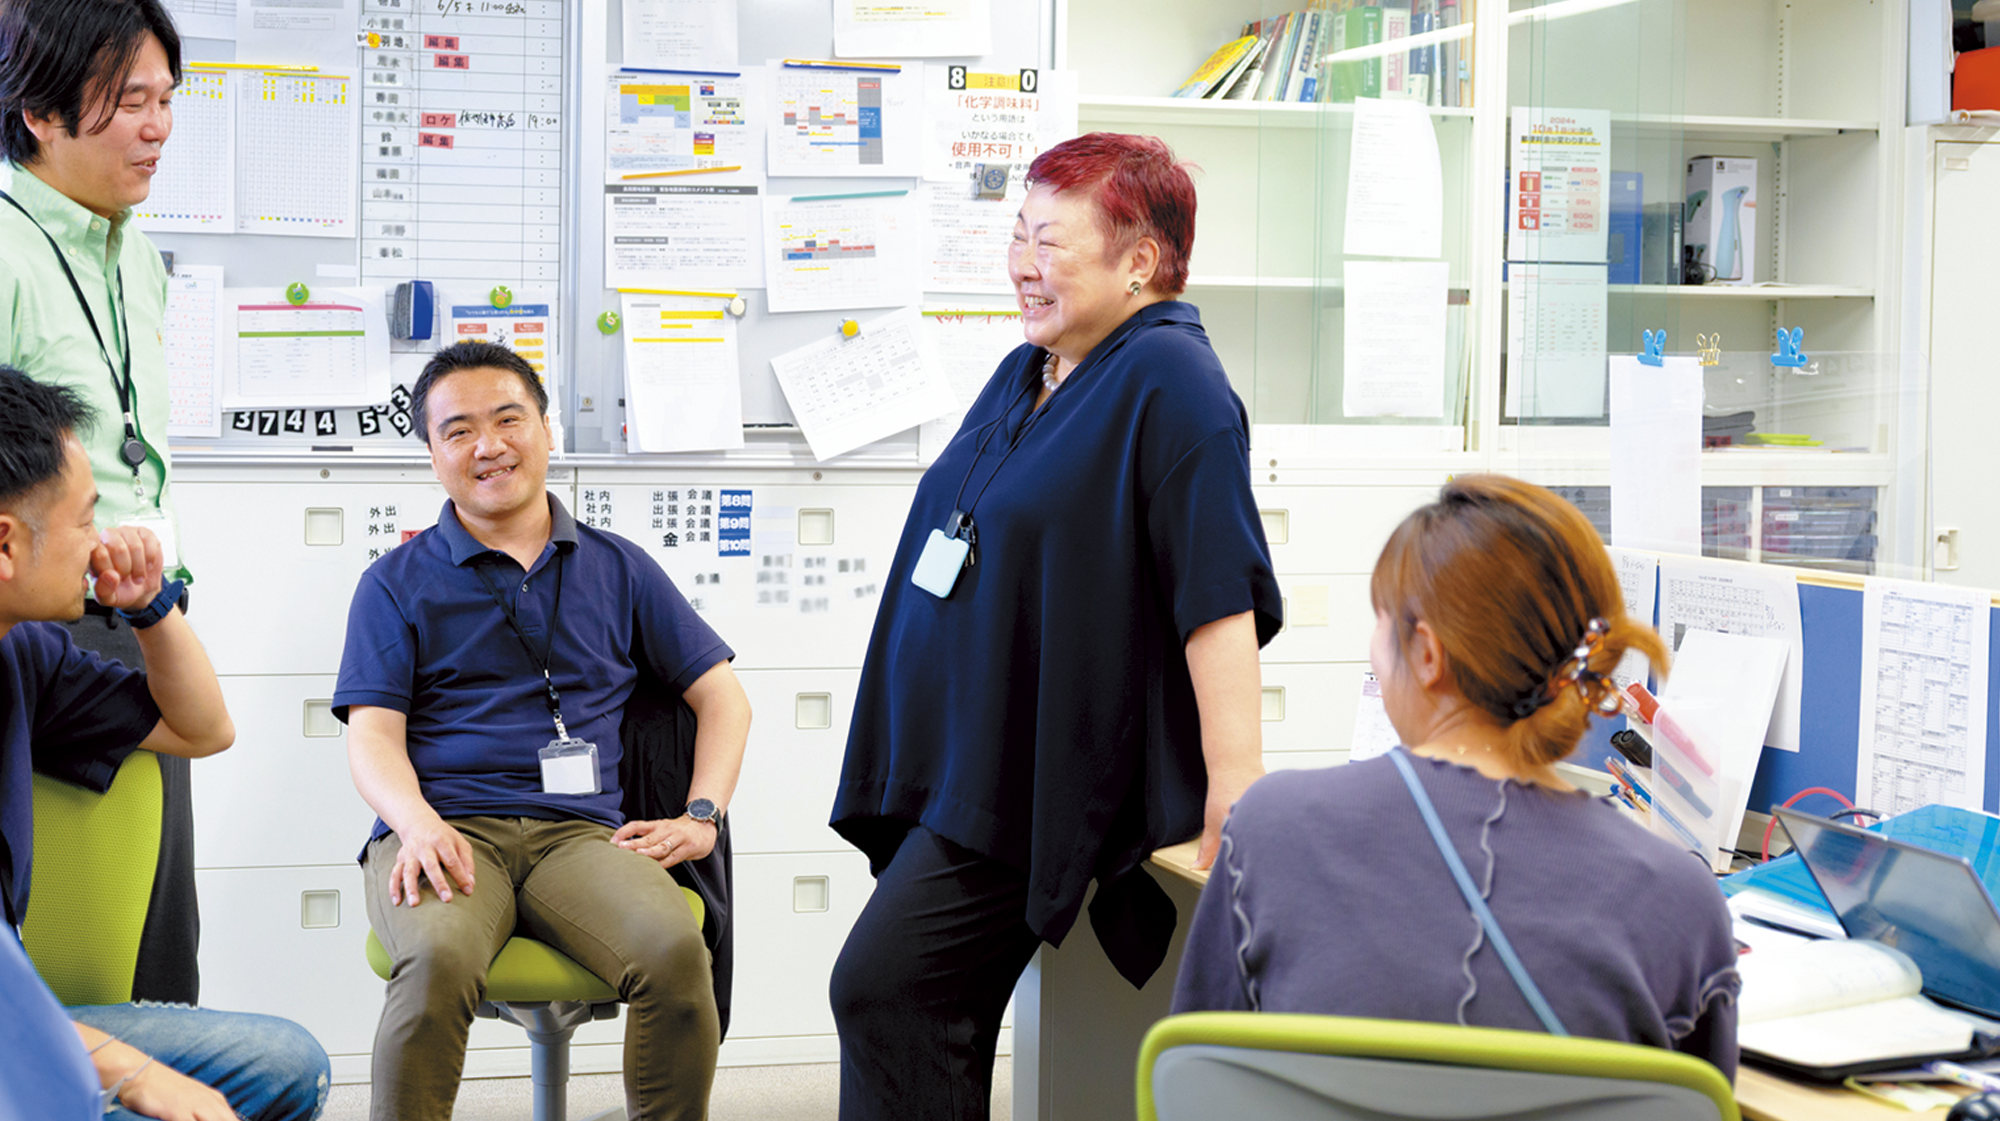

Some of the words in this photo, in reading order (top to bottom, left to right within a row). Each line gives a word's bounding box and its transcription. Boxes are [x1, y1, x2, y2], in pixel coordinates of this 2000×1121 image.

[951, 67, 965, 88] 8
[1022, 70, 1035, 91] 0
[958, 94, 1040, 112] 「化学調味料」
[426, 115, 451, 125] ロケ
[972, 113, 1025, 123] という用語は
[392, 389, 411, 410] 3
[261, 412, 275, 433] 7
[287, 408, 302, 430] 4
[318, 411, 334, 432] 4
[363, 411, 376, 433] 5
[393, 411, 411, 434] 9
[584, 490, 610, 501] 社内
[653, 490, 678, 501] 出張
[688, 489, 712, 500] 会議
[369, 505, 397, 518] 外出
[586, 503, 611, 514] 社内
[653, 504, 678, 515] 出張
[686, 504, 711, 515] 会議
[586, 516, 611, 527] 社内
[652, 518, 677, 528] 出張
[686, 518, 710, 528] 会議
[368, 522, 395, 536] 外出
[663, 532, 678, 547] 金
[686, 531, 710, 542] 会議
